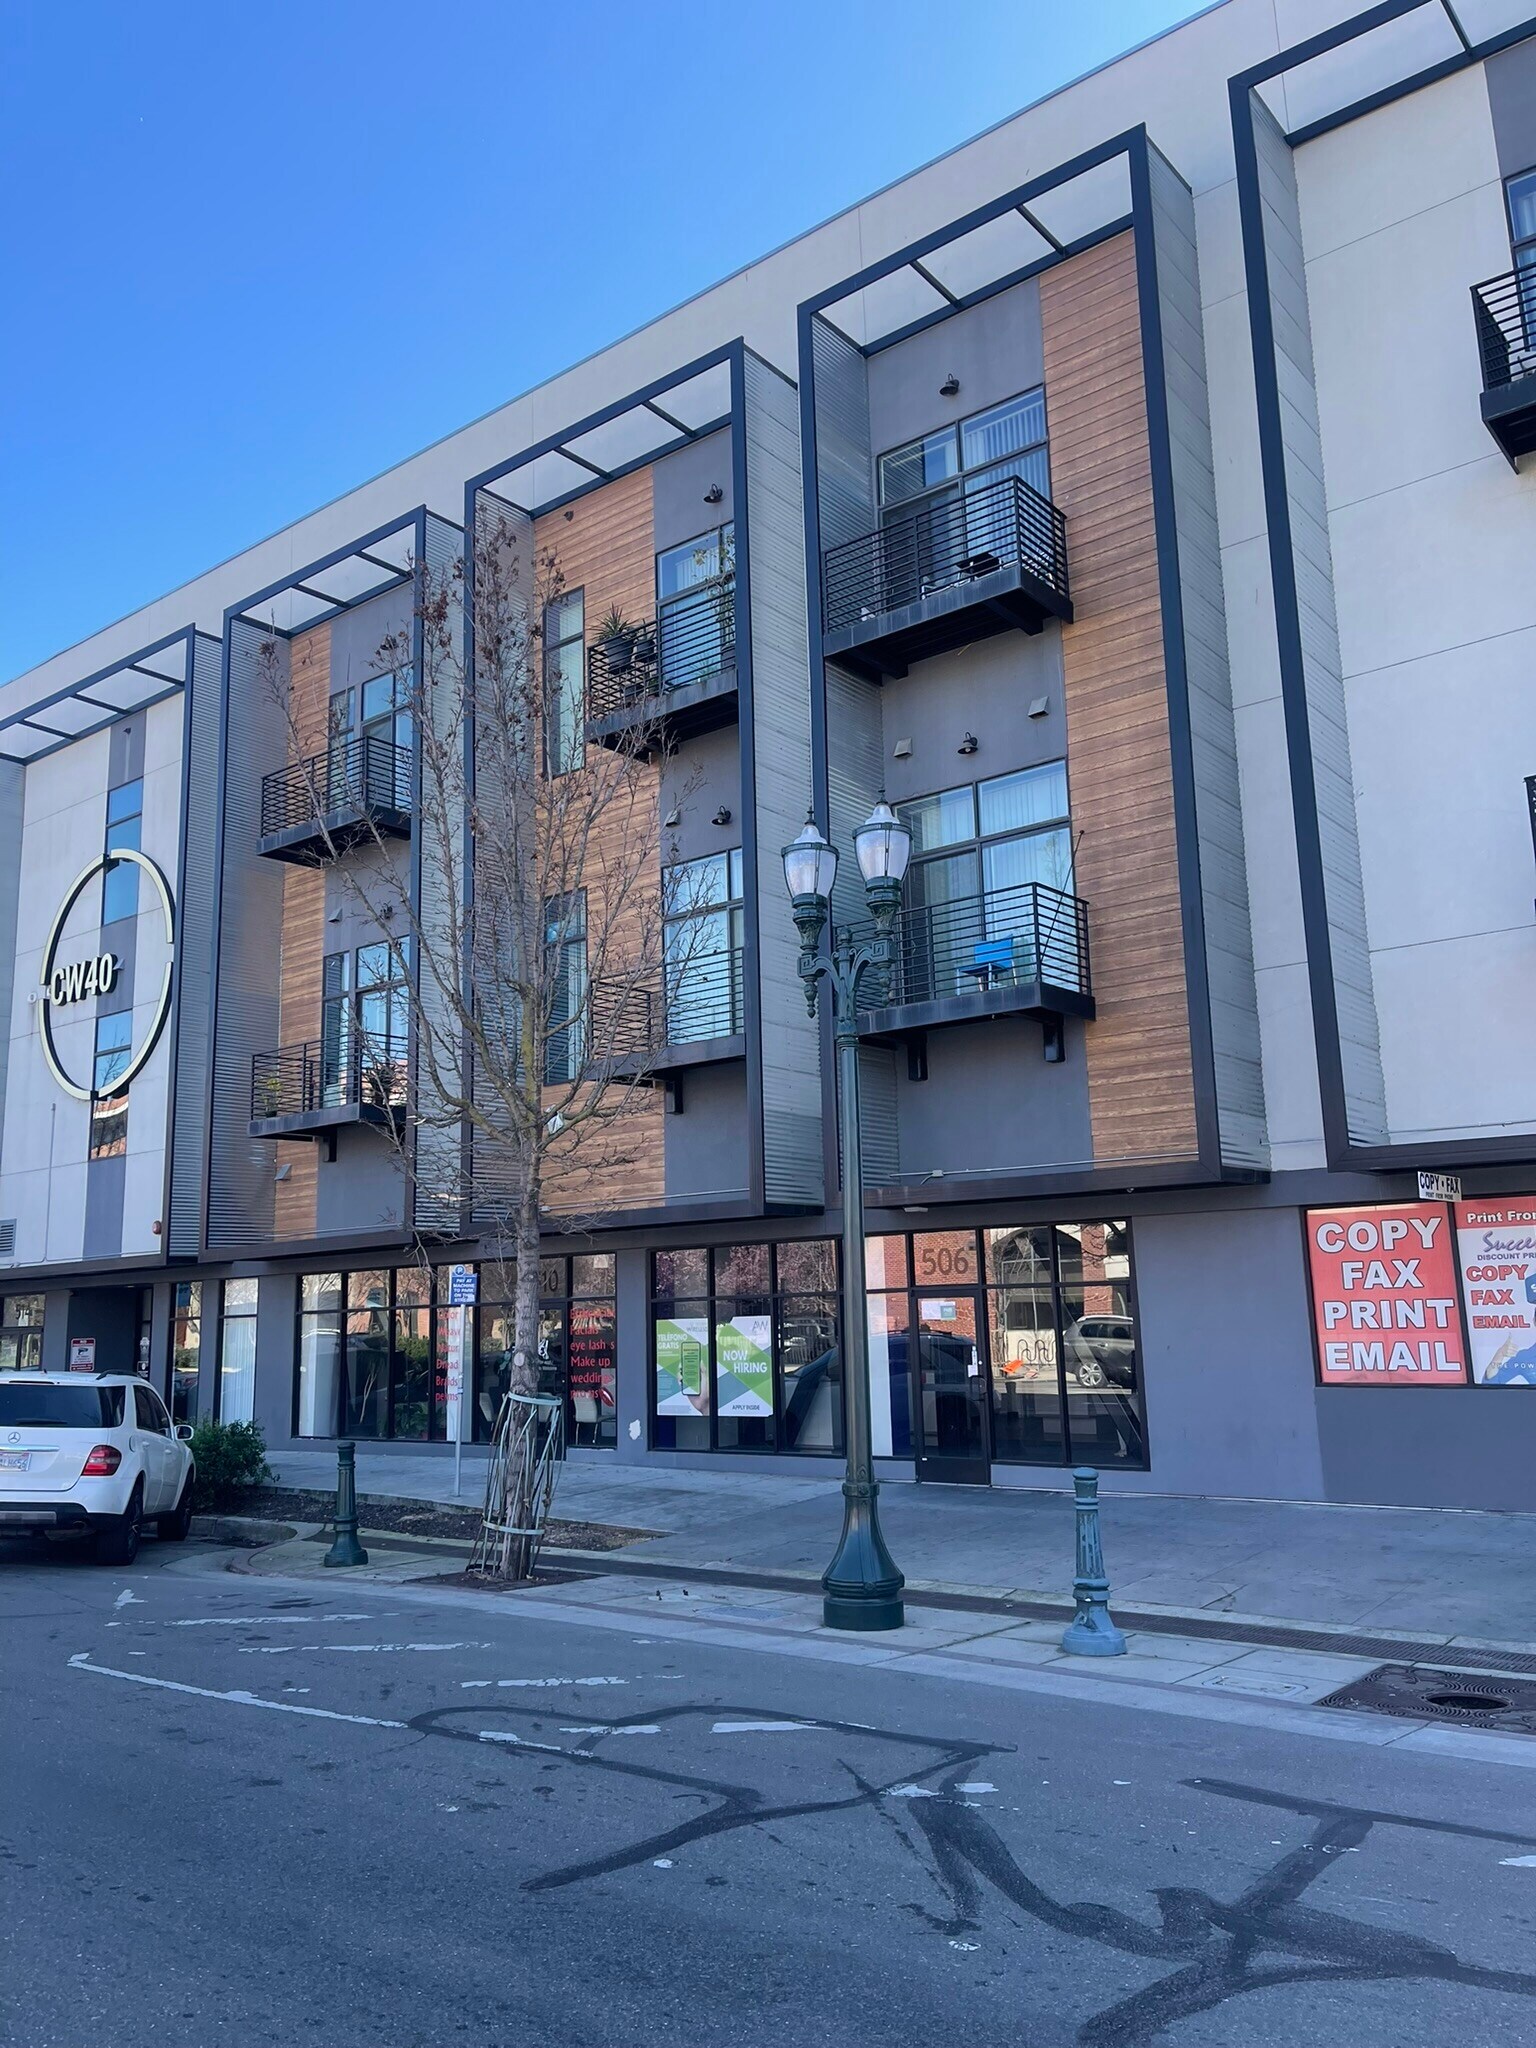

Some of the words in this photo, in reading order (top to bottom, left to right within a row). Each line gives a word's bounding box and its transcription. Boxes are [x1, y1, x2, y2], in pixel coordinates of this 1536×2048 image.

[51, 952, 116, 1006] CW40
[1419, 1172, 1440, 1191] COPY
[1446, 1177, 1460, 1194] FAX
[1467, 1212, 1503, 1224] Print
[1316, 1217, 1442, 1253] COPY
[1482, 1230, 1536, 1253] Succe
[922, 1247, 969, 1275] 506
[1477, 1253, 1521, 1261] DISCOUNT
[540, 1268, 559, 1292] 10
[1341, 1258, 1425, 1290] FAX
[1466, 1264, 1529, 1282] COPY
[1471, 1289, 1515, 1305] FAX
[1323, 1298, 1455, 1329] PRINT
[1473, 1315, 1531, 1329] EMAIL
[570, 1325, 599, 1336] Facials
[657, 1332, 688, 1341] TELÉFONO
[570, 1341, 586, 1352] eye
[657, 1341, 680, 1349] GRATIS
[570, 1356, 595, 1367] Make
[598, 1358, 611, 1367] up
[723, 1350, 748, 1361] NOW
[1325, 1341, 1462, 1372] EMAIL
[733, 1362, 768, 1373] HIRING
